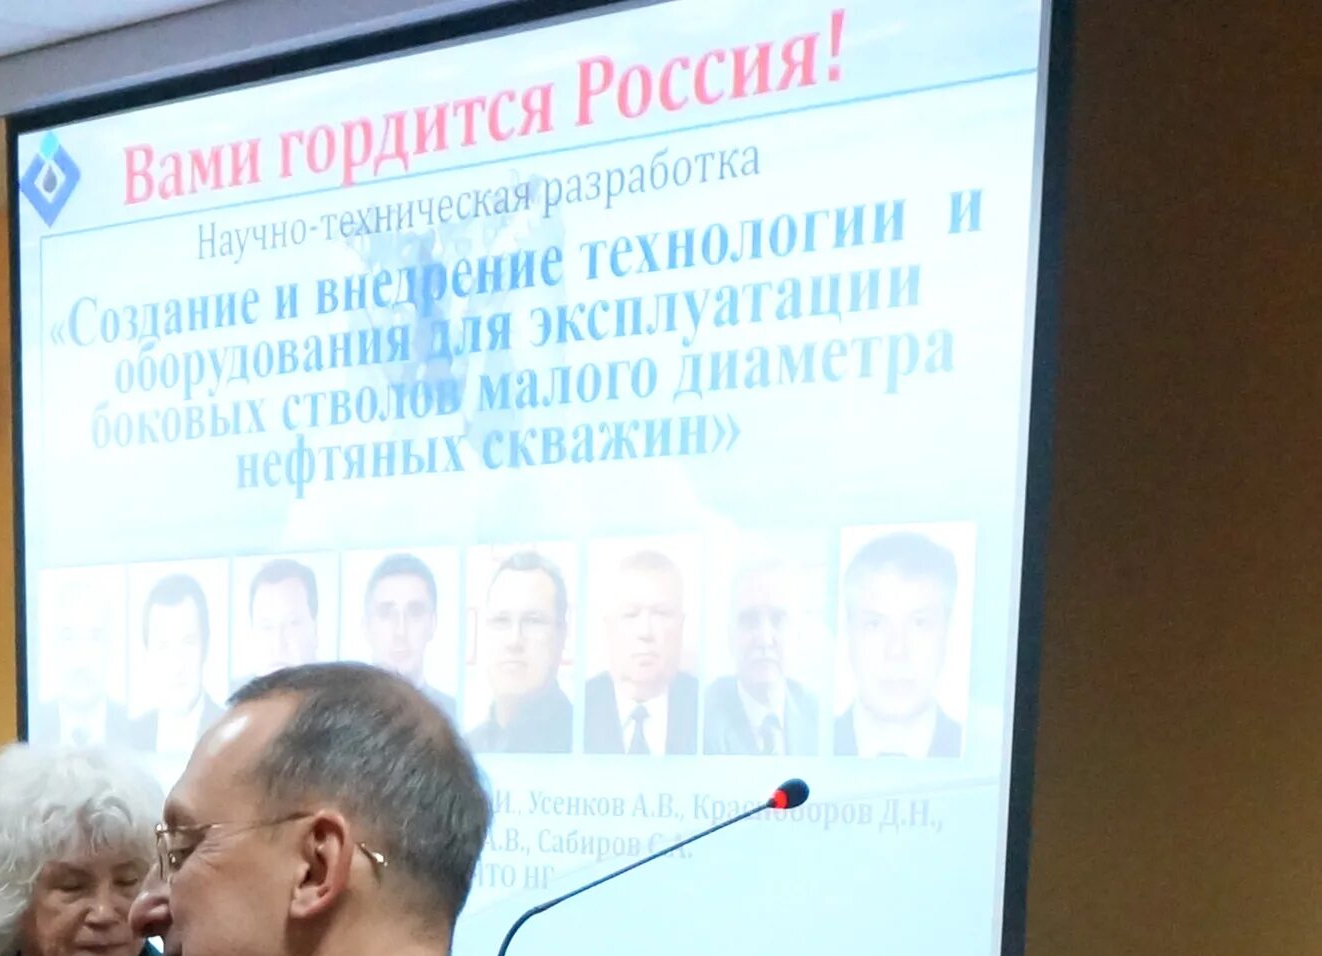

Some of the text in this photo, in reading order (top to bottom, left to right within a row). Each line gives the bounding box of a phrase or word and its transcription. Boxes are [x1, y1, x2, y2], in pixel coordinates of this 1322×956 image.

[123, 8, 846, 206] Вами гордится Россия!
[197, 144, 760, 264] Научно-техническая разработка
[49, 188, 982, 348] «Создание и внедрение технологии и
[92, 327, 955, 449] боковых стволов малого диаметра
[116, 264, 921, 399] оборудования для эксплуатации
[237, 412, 741, 499] нефтяных скважин»
[528, 790, 625, 817] Усенков
[538, 828, 640, 862] Сабиров
